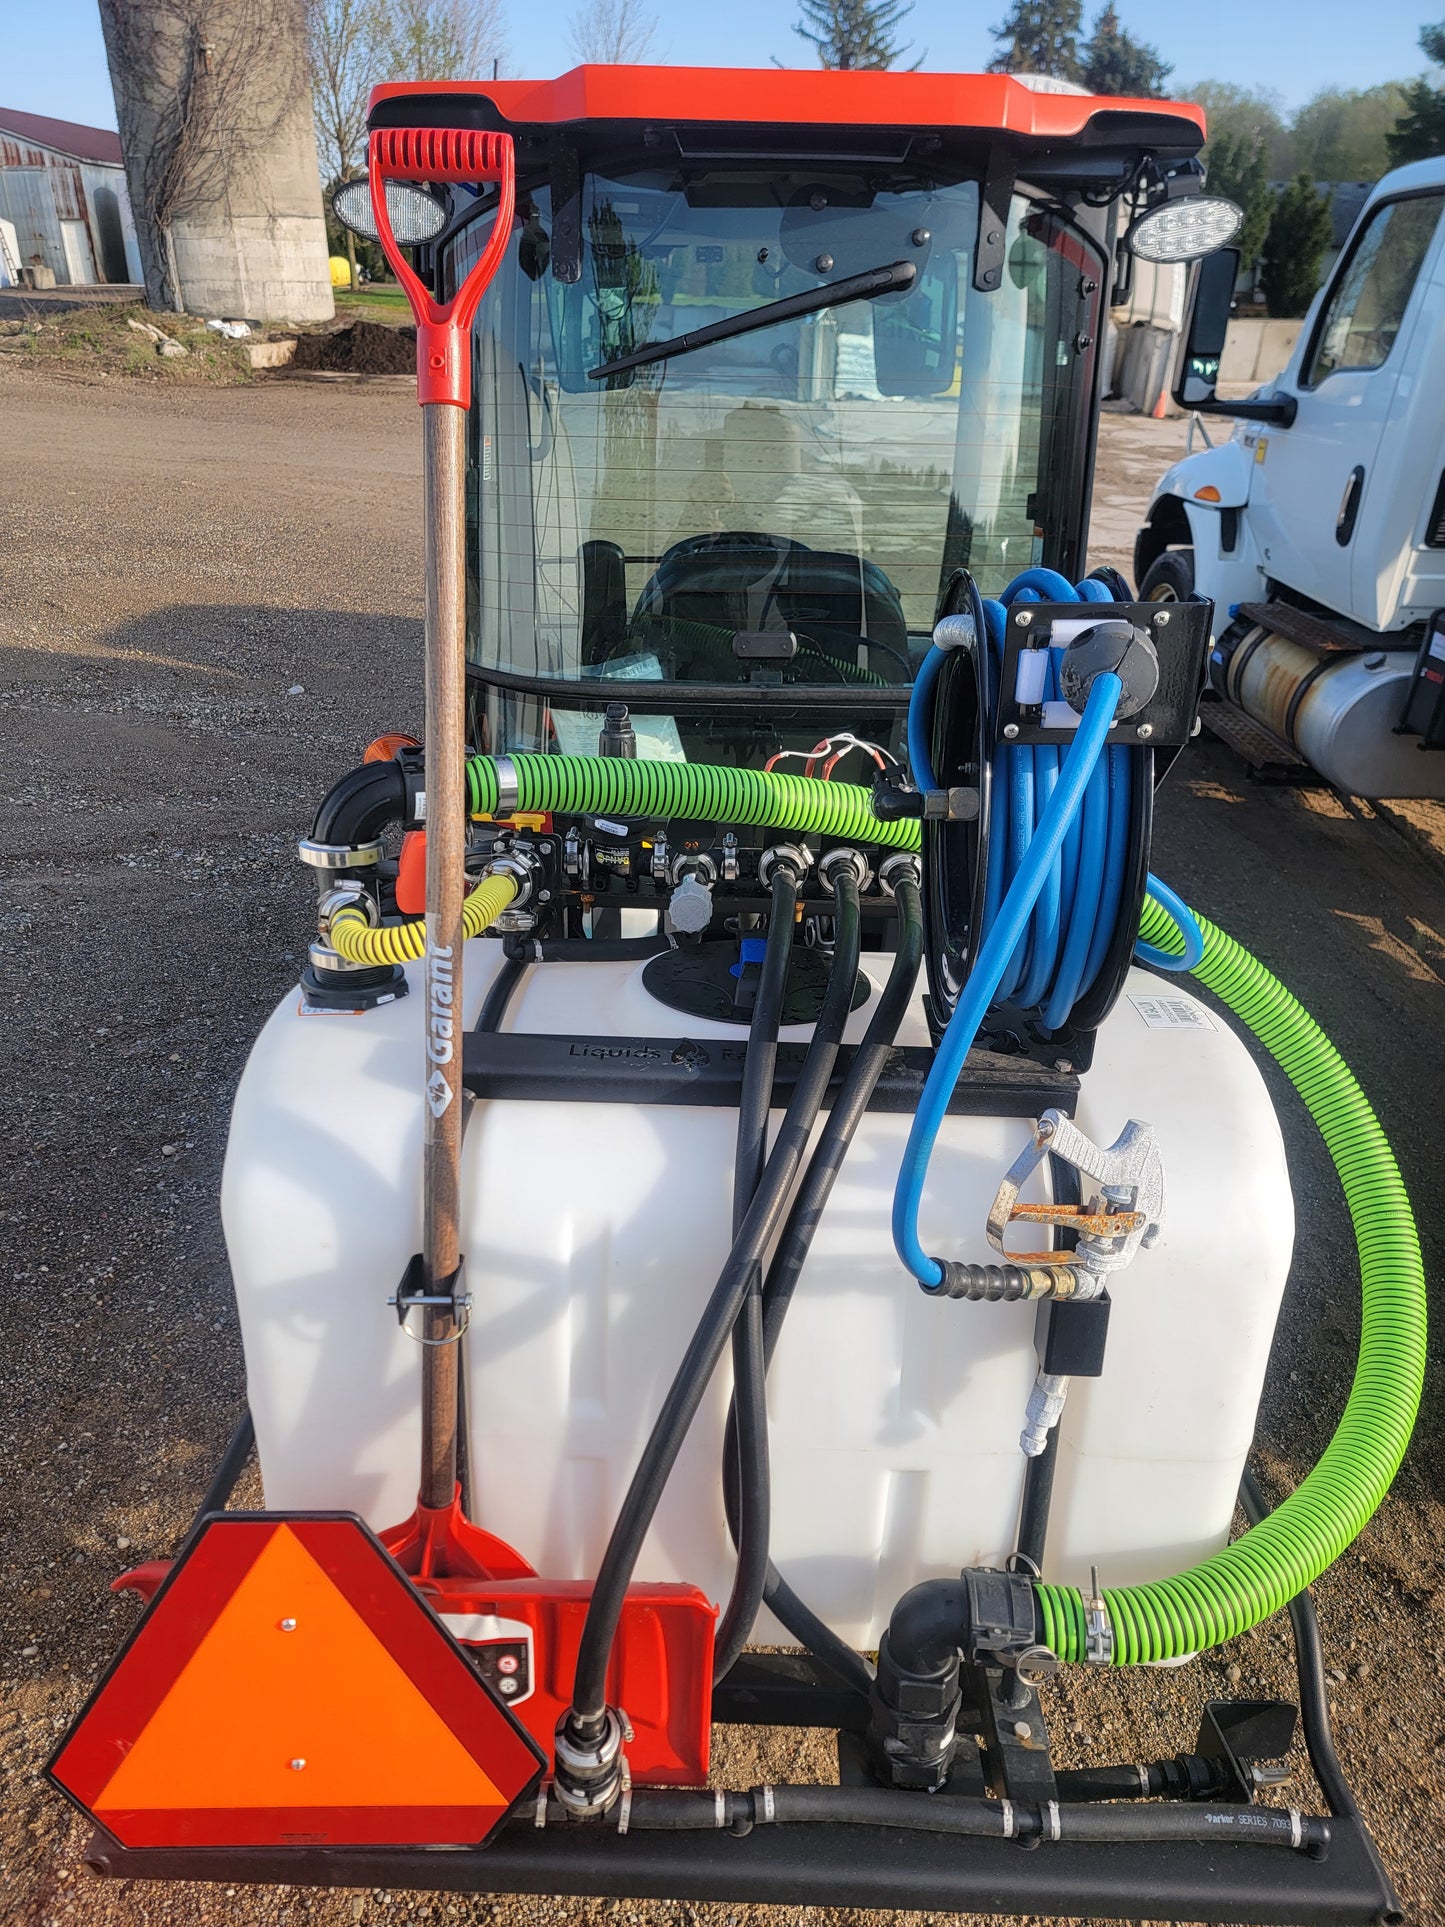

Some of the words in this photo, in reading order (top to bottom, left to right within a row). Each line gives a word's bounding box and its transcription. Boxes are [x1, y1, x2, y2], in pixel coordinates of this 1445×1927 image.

[427, 941, 454, 1065] Garant
[569, 1043, 661, 1060] Liquids
[1205, 1813, 1235, 1824] Parker
[1237, 1814, 1268, 1826] SERIES
[1271, 1817, 1291, 1830] 7093
